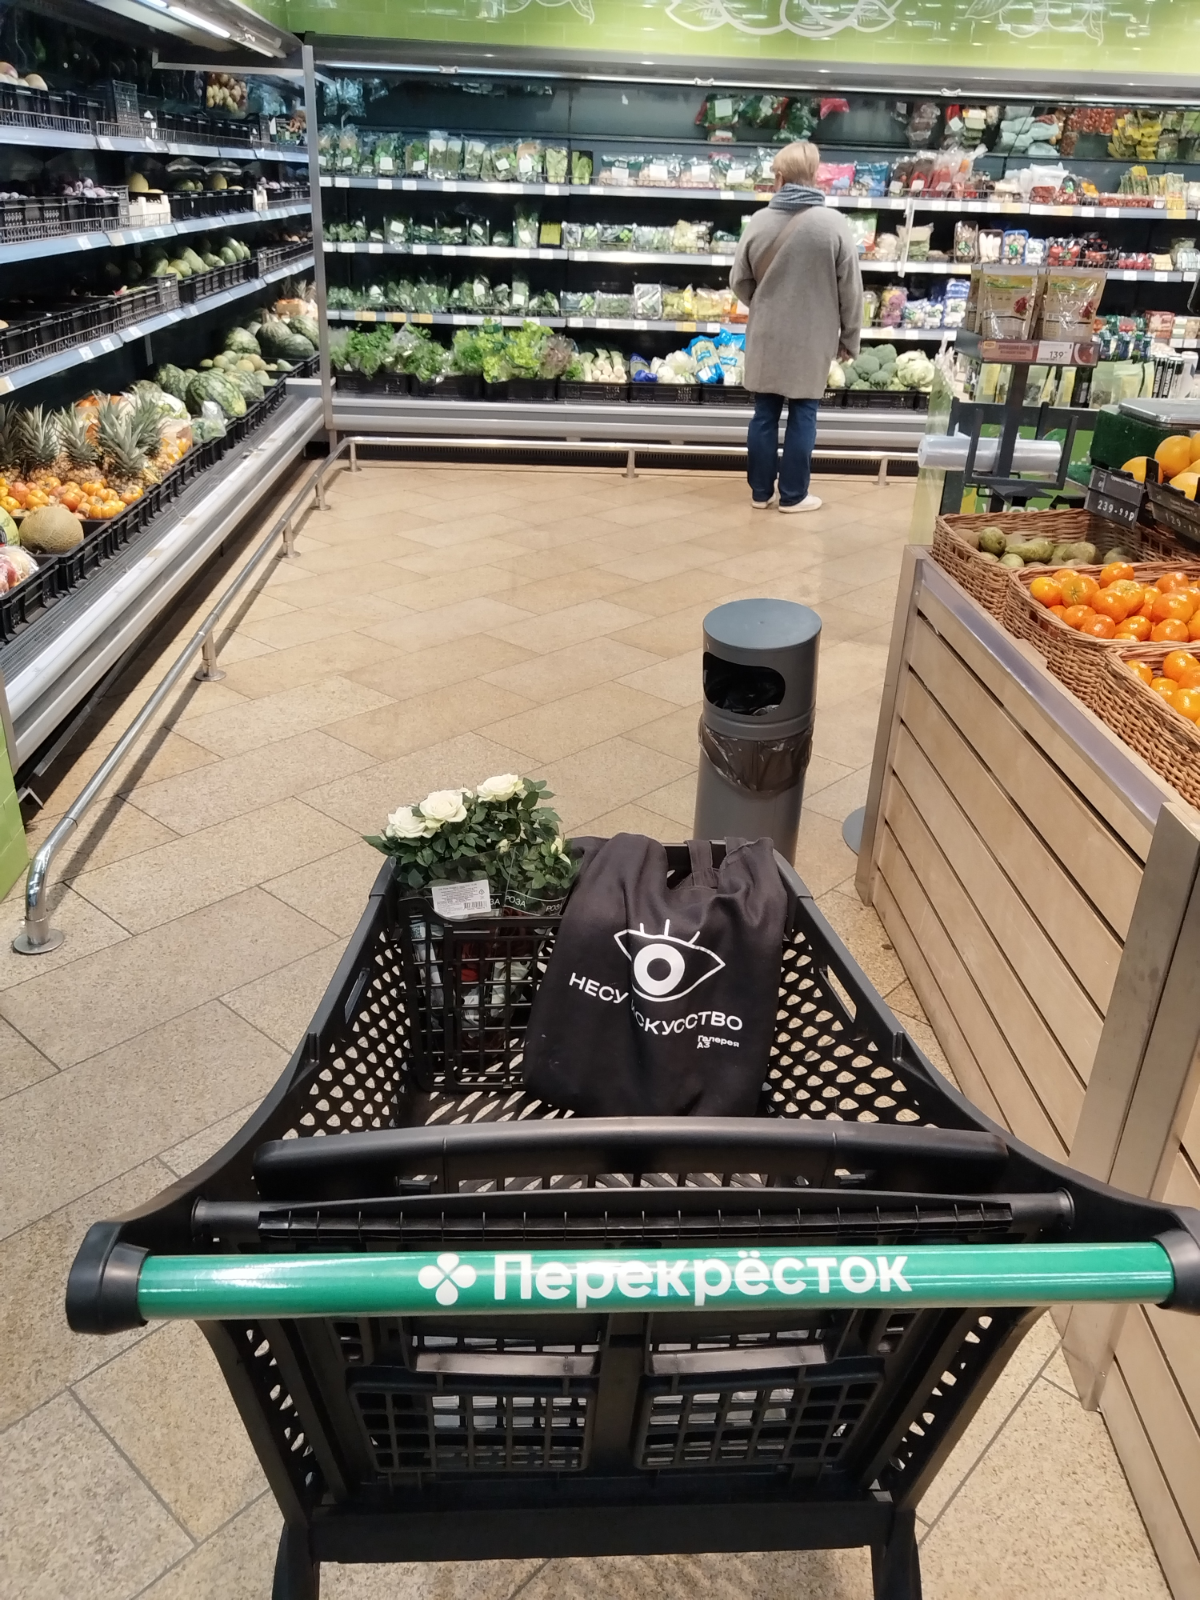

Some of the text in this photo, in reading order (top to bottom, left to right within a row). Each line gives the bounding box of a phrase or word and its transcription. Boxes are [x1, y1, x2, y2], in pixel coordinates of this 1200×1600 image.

[505, 895, 526, 907] РОЗА
[569, 972, 629, 1004] НЕСУ
[697, 1035, 740, 1048] Галерея
[494, 1250, 912, 1309] Перекрёсток
